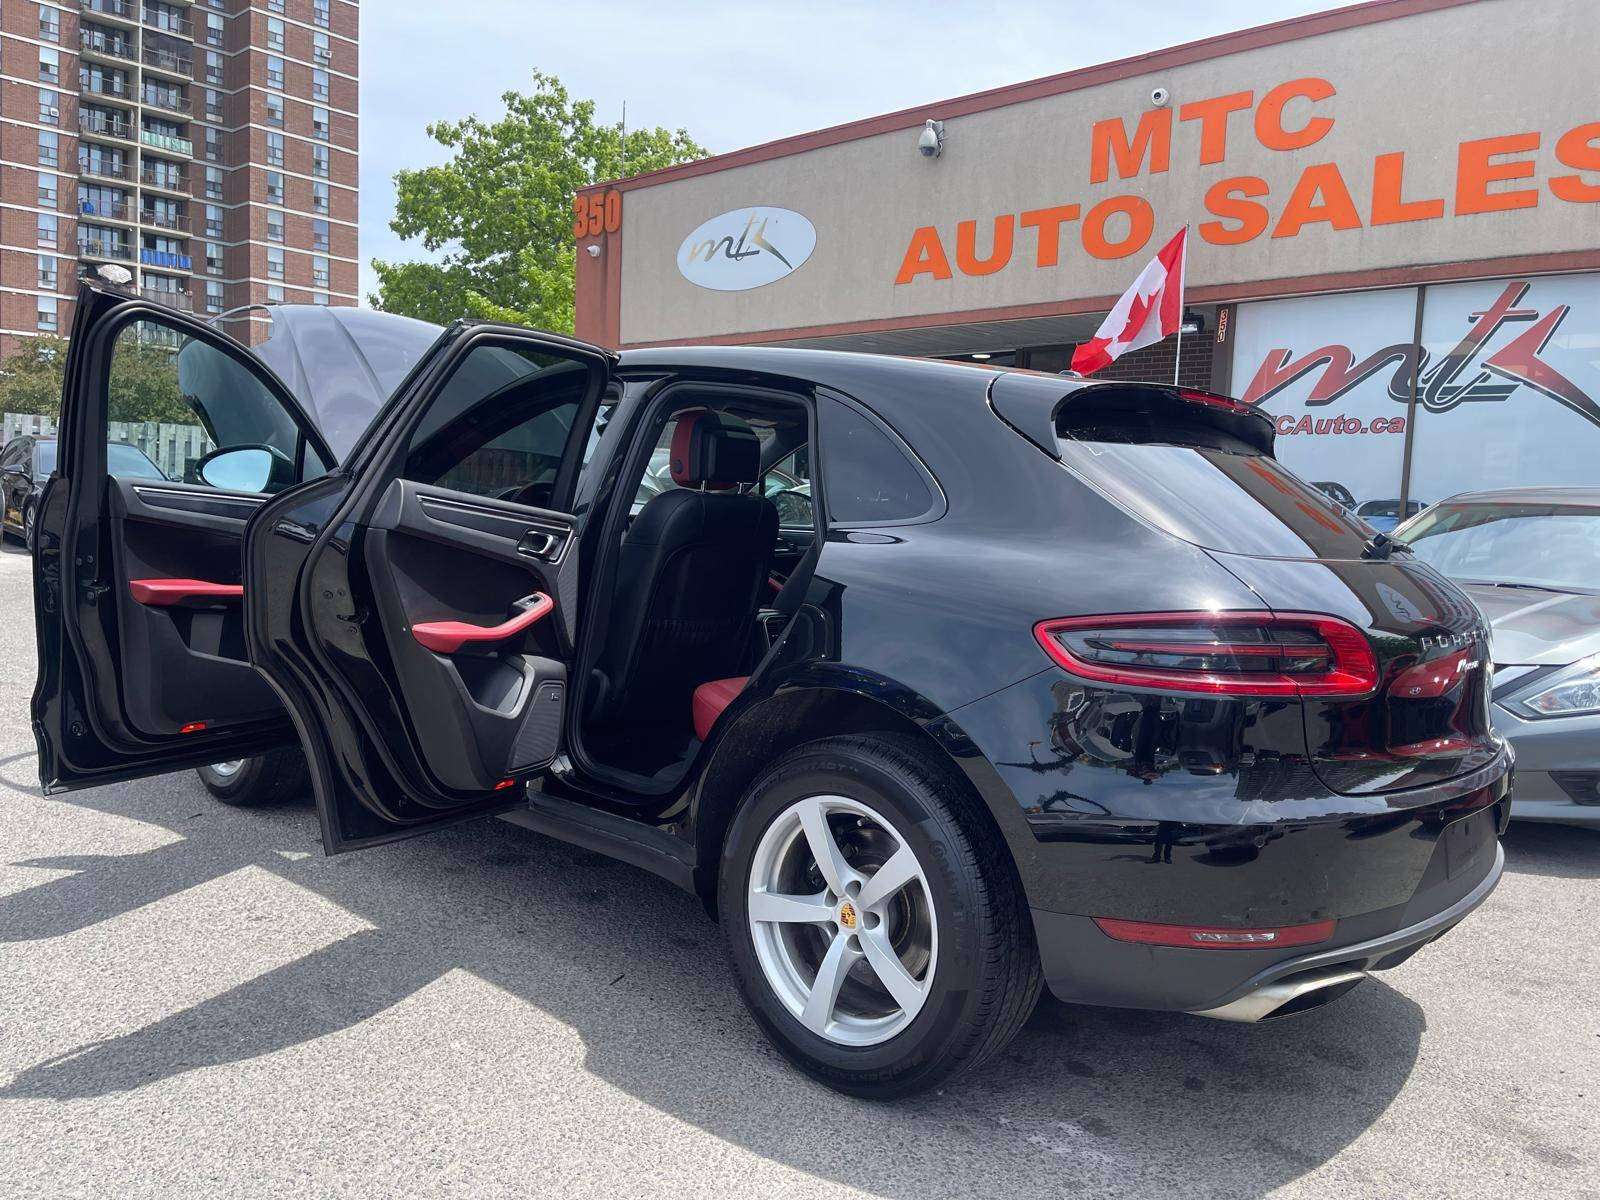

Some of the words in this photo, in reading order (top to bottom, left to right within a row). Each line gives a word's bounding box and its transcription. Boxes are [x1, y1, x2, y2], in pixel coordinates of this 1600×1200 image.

[1090, 77, 1336, 183] MTC
[574, 191, 620, 238] 350
[895, 195, 1154, 285] AUTO
[1198, 121, 1600, 246] SALES
[1218, 309, 1228, 342] 350
[1273, 413, 1406, 436] CAuto.ca
